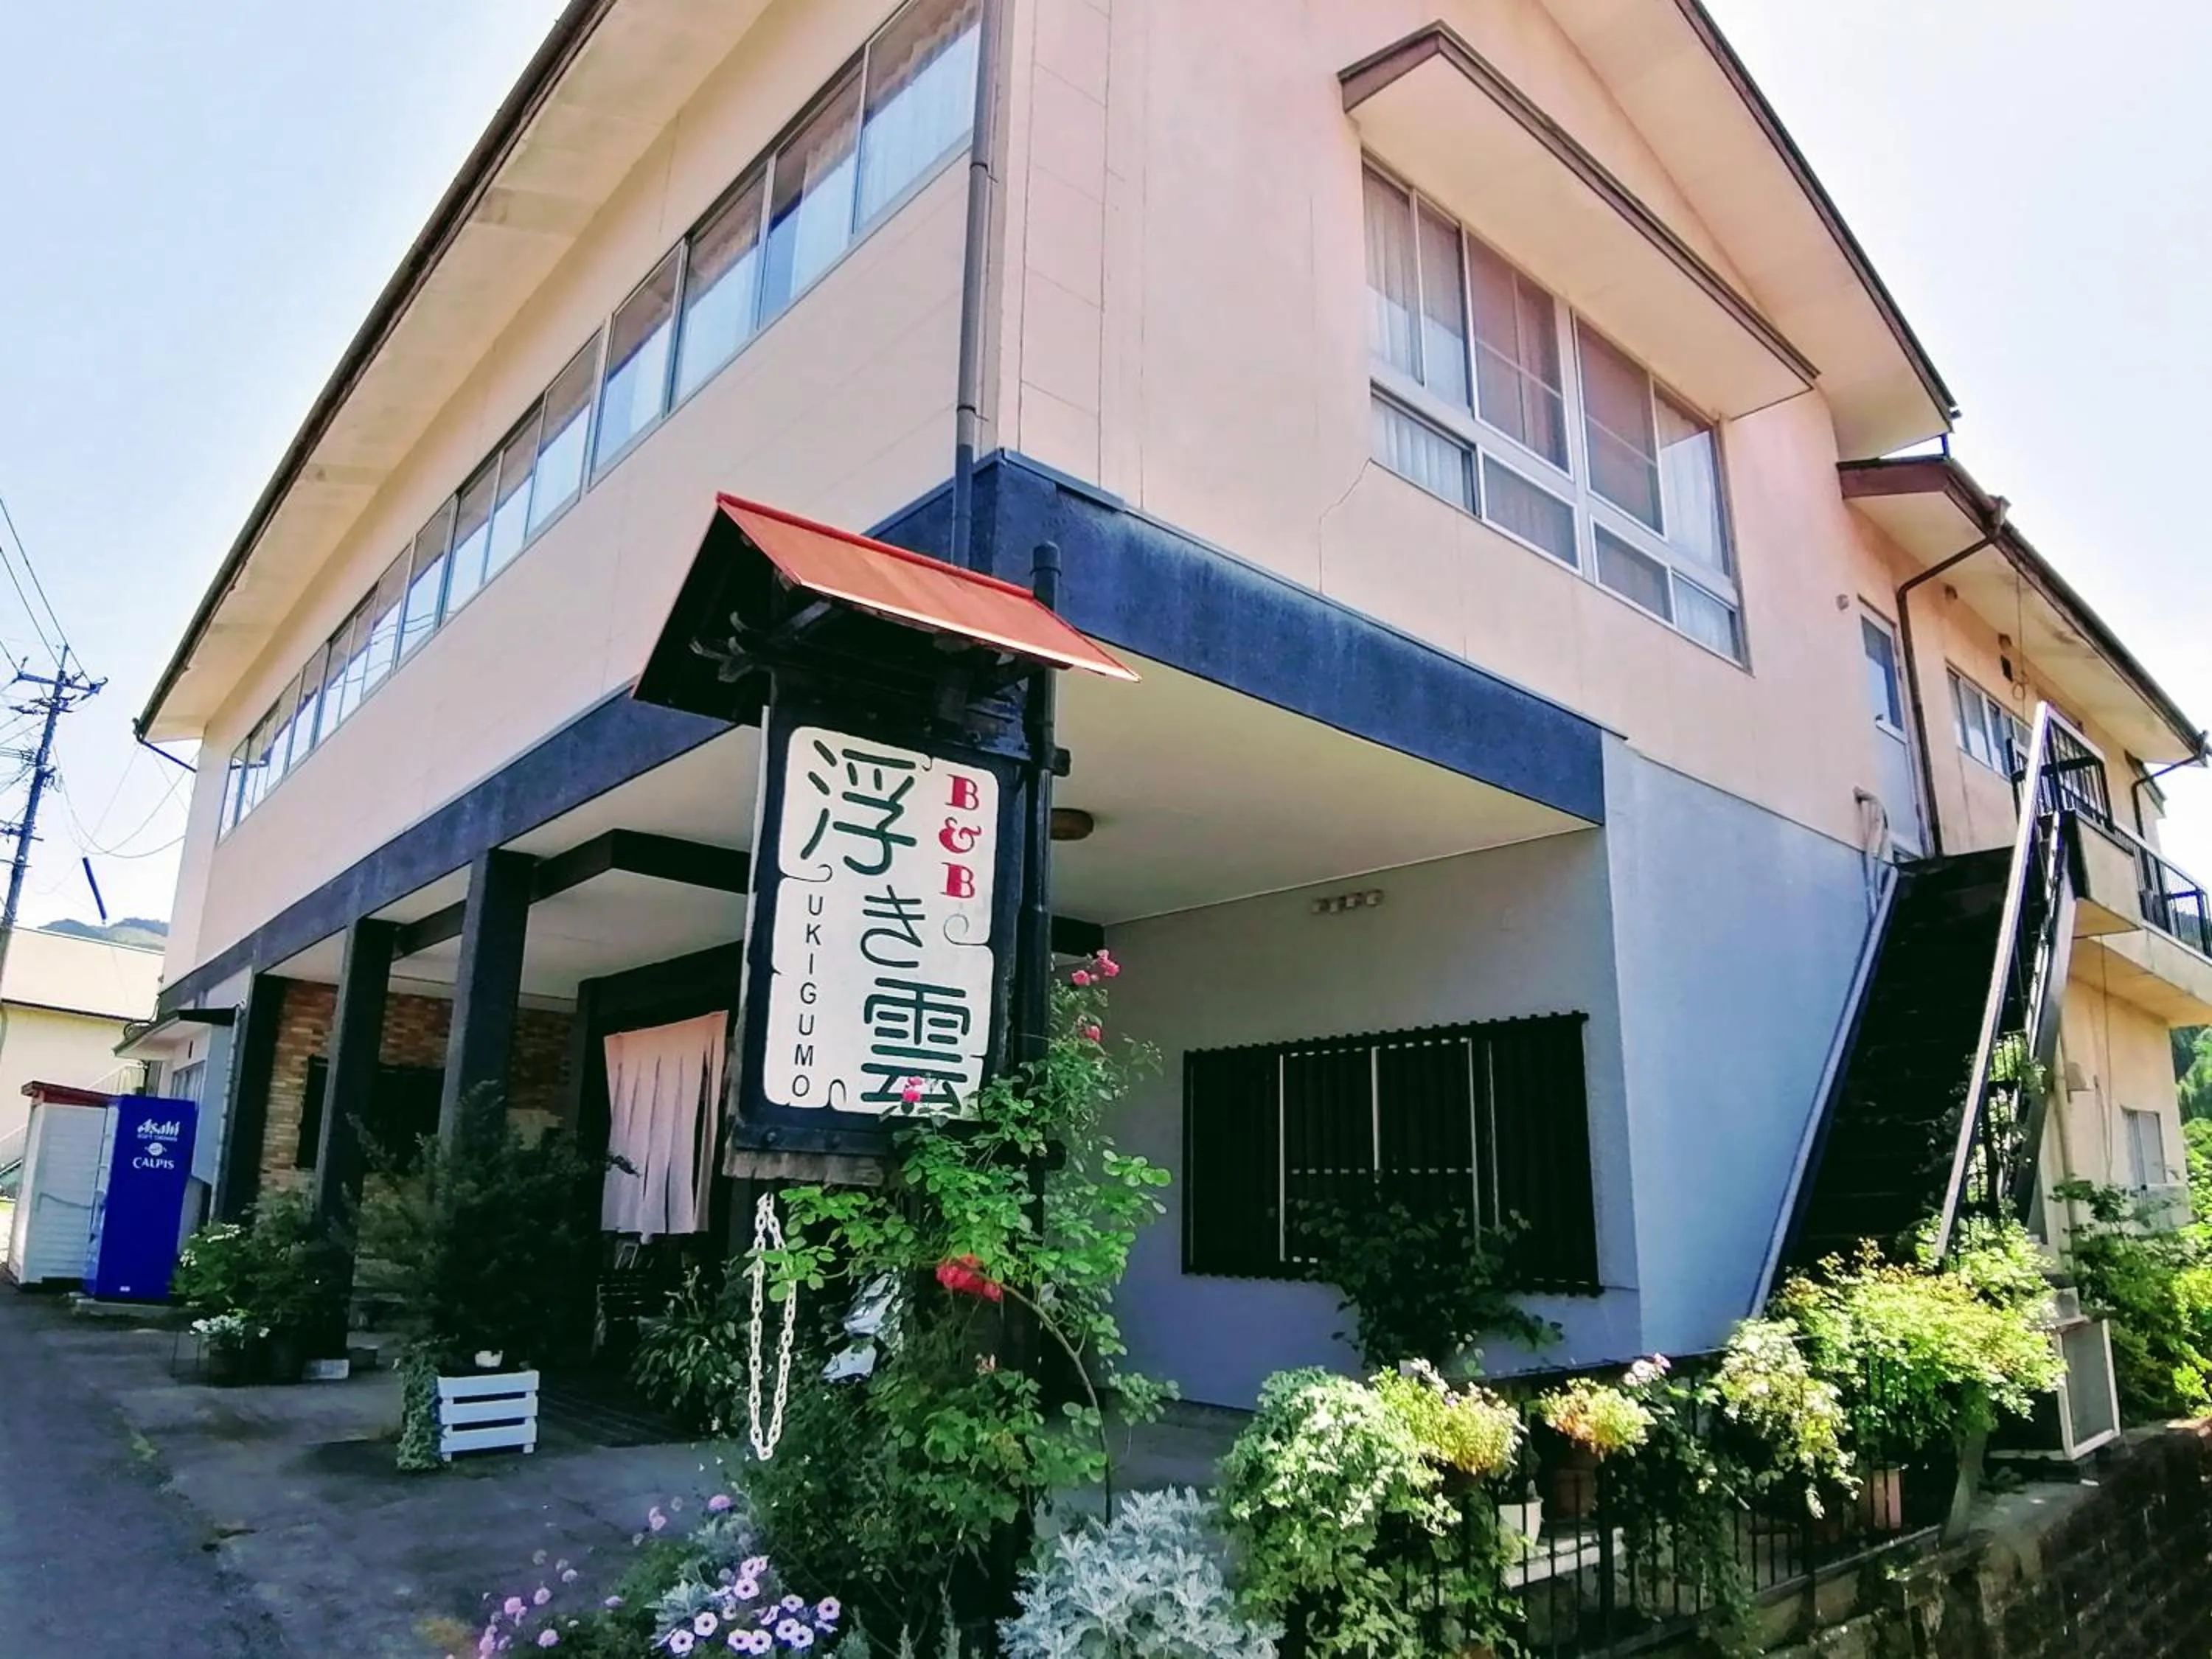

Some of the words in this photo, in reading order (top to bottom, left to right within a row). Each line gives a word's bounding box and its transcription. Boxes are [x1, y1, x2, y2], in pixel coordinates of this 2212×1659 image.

[939, 773, 982, 899] B&B
[801, 740, 970, 1115] 浮き雲
[791, 894, 824, 1098] UKIGUMO
[133, 1157, 175, 1169] CALPIS
[137, 1119, 180, 1136] Asahi
